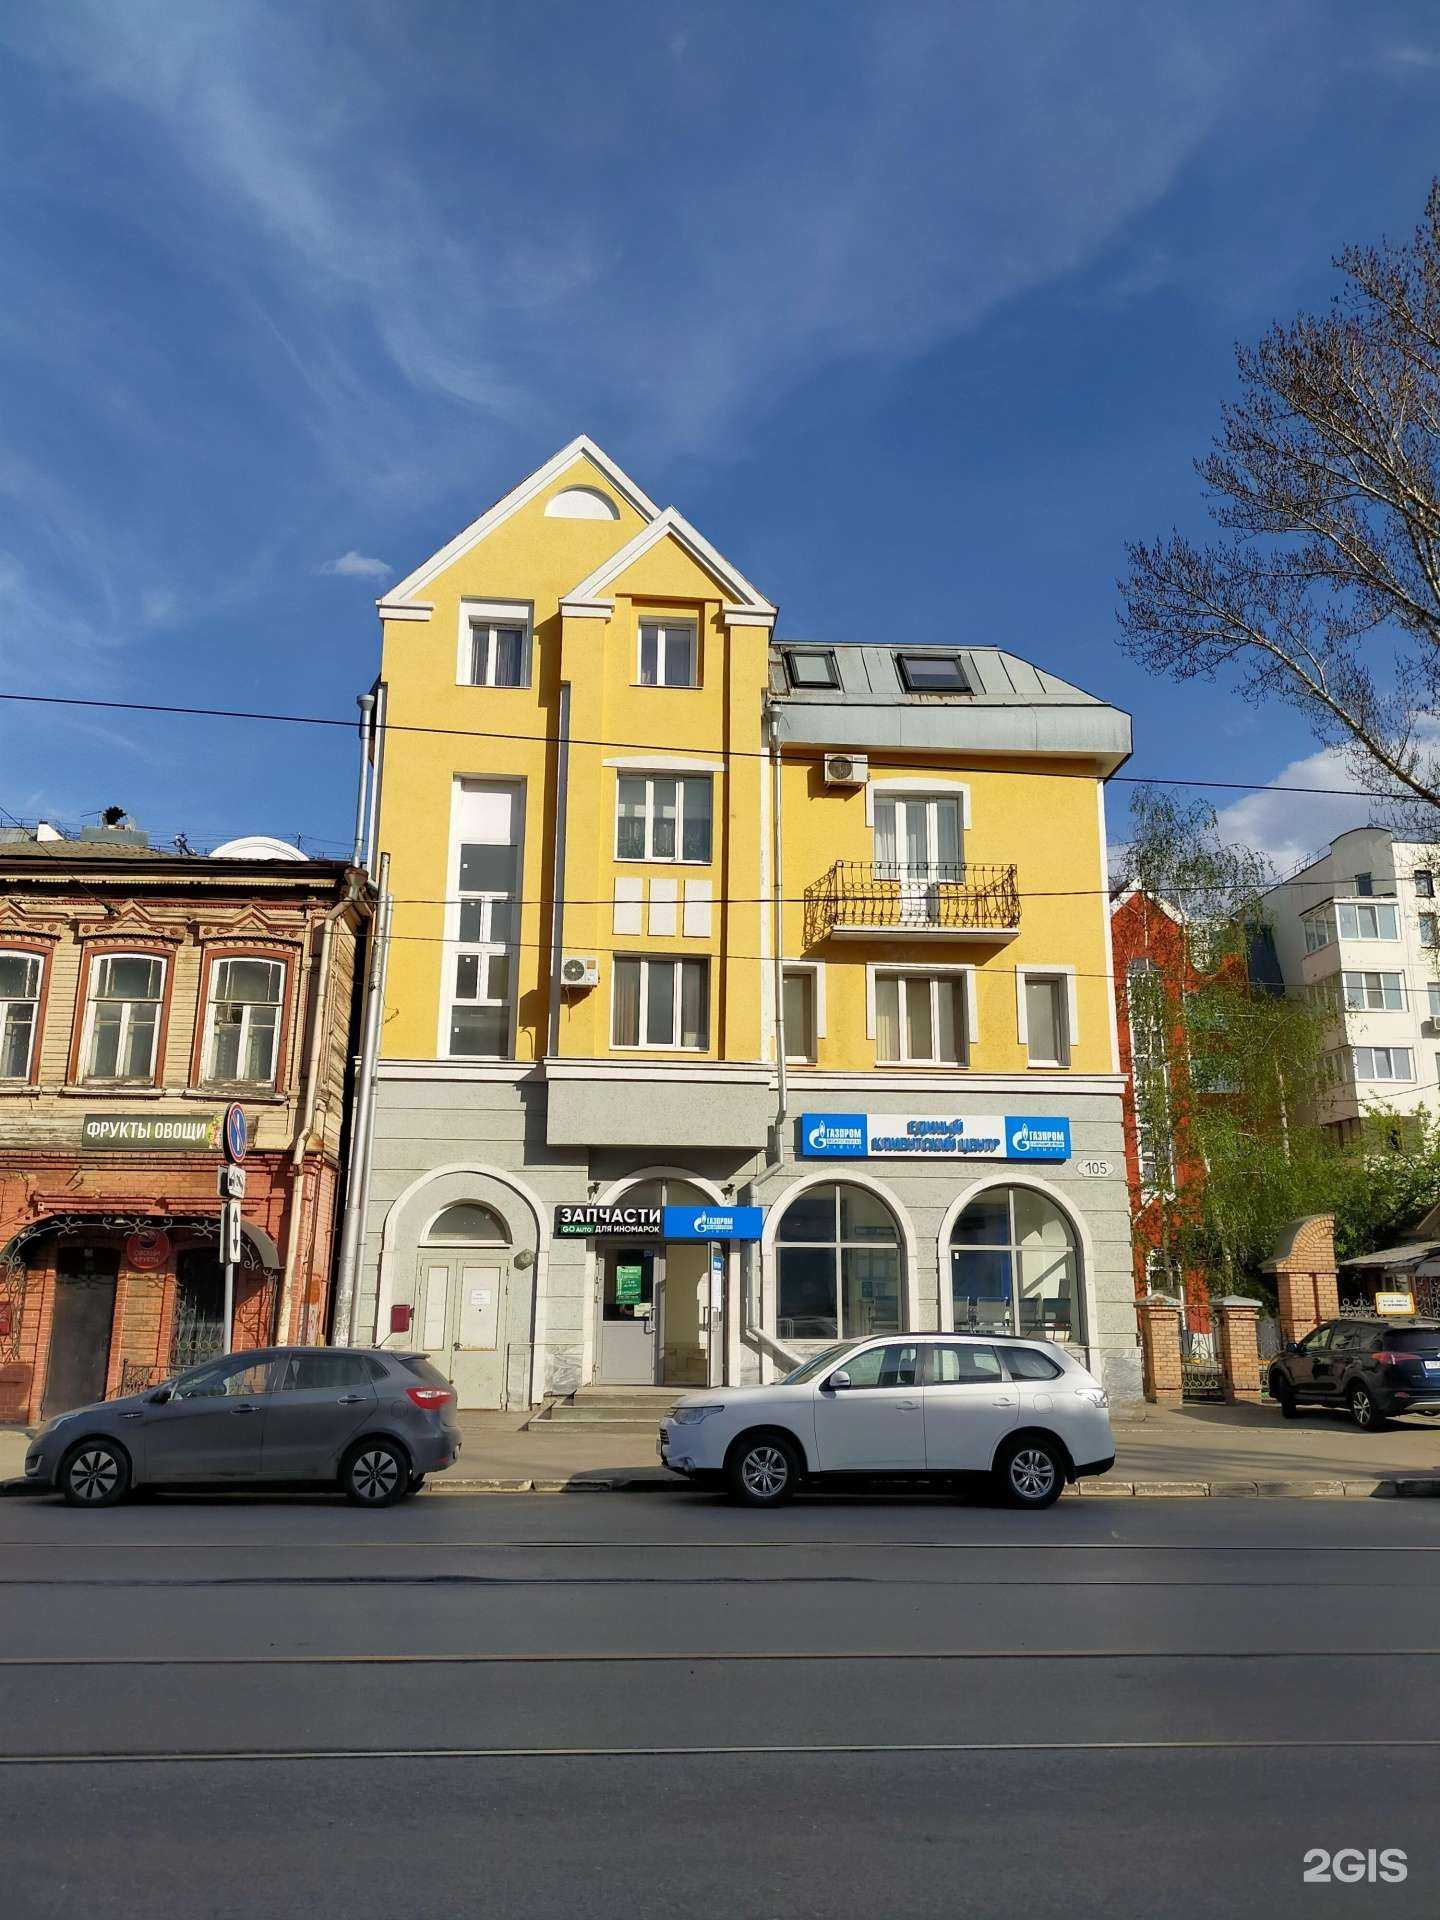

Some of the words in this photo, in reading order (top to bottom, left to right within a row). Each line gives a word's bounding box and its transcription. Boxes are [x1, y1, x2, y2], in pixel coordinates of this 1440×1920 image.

[86, 1121, 151, 1138] ФРУКТЫ
[154, 1122, 207, 1140] ОВОЩИ
[826, 1128, 862, 1138] ГАЗПРОМ
[1029, 1131, 1064, 1141] ГАЗПРОМ
[1085, 1162, 1107, 1175] 105
[561, 1208, 661, 1223] ЗАПЧАСТИ
[562, 1225, 576, 1233] GO
[595, 1225, 612, 1233] ДЛЯ
[613, 1225, 660, 1233] ИНОМАРОК
